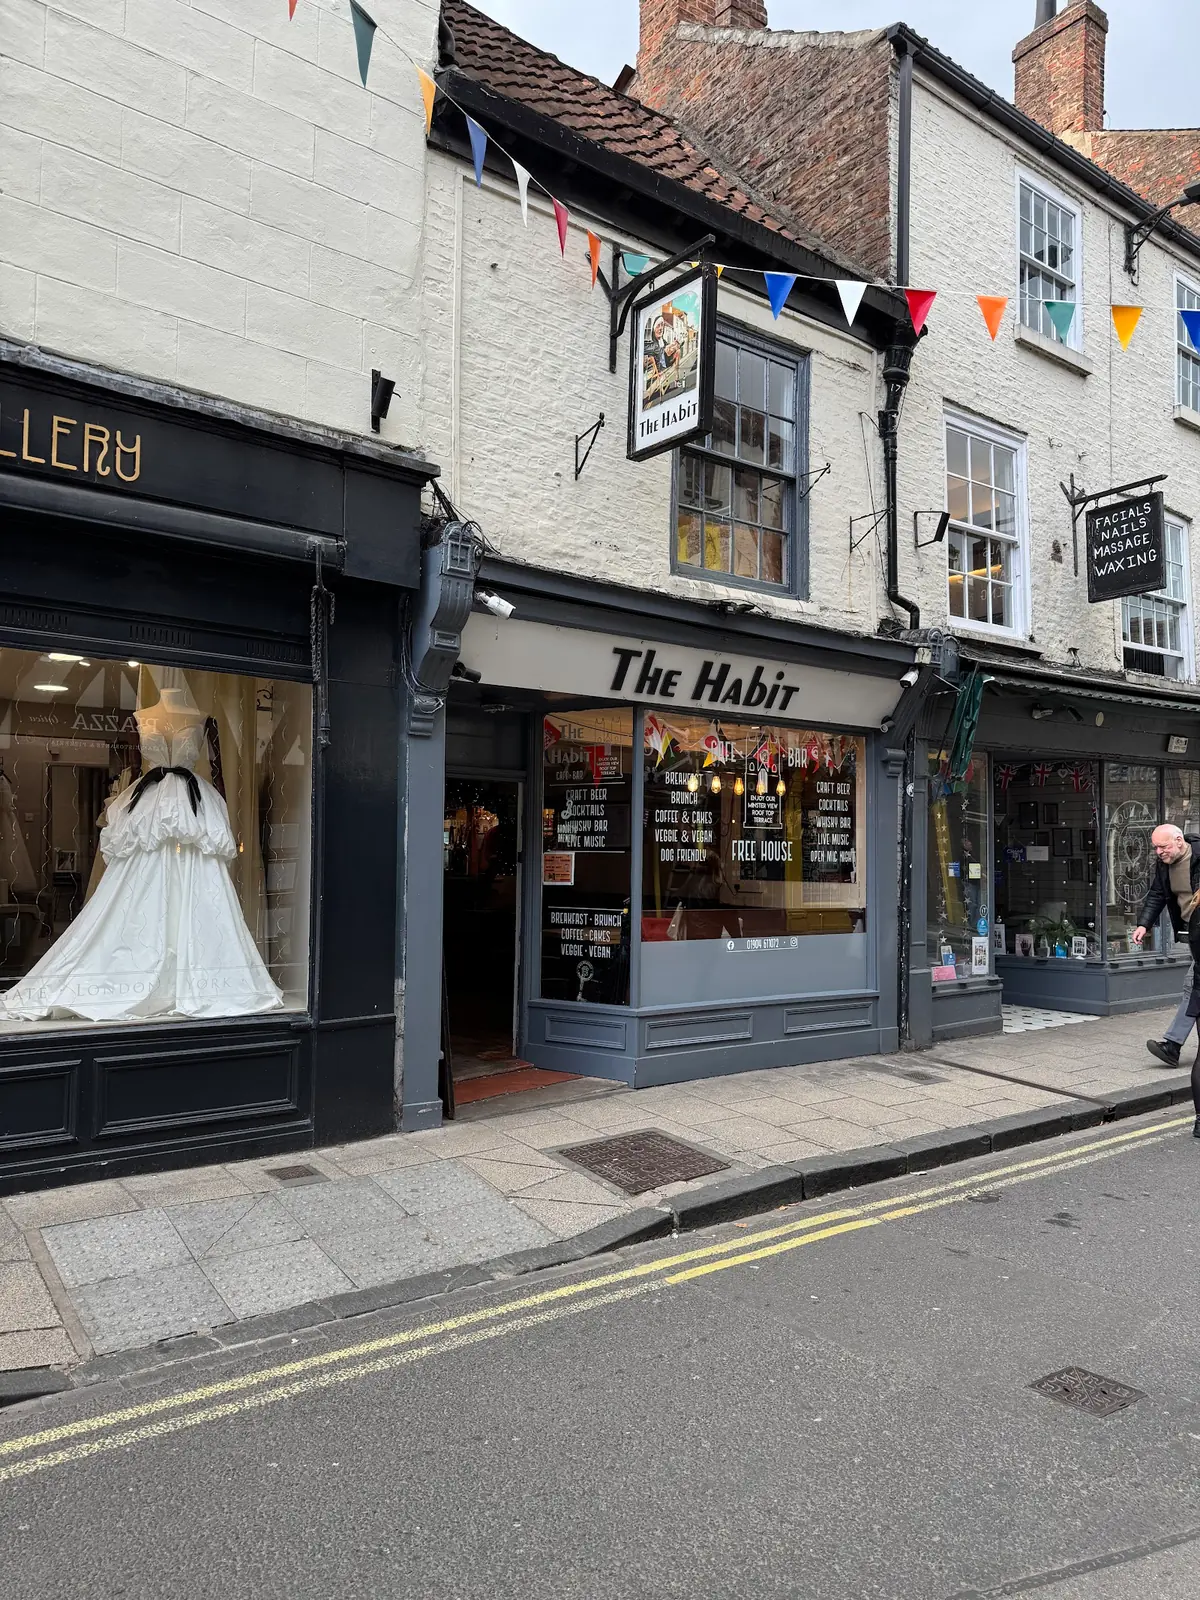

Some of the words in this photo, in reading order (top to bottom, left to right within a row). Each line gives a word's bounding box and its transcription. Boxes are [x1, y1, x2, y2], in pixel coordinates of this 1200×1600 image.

[1095, 502, 1152, 529] FACIALS
[1101, 517, 1147, 541] NAILS
[1094, 532, 1151, 559] MASSAGE
[1095, 548, 1158, 577] WAXING
[787, 747, 808, 768] BAR
[566, 789, 587, 800] CRAFT
[590, 788, 607, 800] BEER
[816, 782, 835, 794] CRAFT
[836, 782, 850, 795] BEER
[671, 791, 698, 804] BRUNCH
[818, 799, 848, 812] COCKTAILS
[655, 810, 678, 823] COFFEE
[681, 811, 690, 824] &
[692, 811, 713, 824] CAKES
[816, 816, 839, 829] WHISKY
[840, 817, 851, 829] BAR
[594, 820, 608, 832] BAR
[583, 836, 606, 847] MUSIC
[655, 829, 678, 842] VEGGIE
[681, 830, 690, 843] &
[692, 830, 713, 843] VEGAN
[817, 833, 830, 845] LIVE
[831, 834, 850, 846] MUSIC
[660, 849, 675, 861] DOG
[676, 849, 707, 862] FRIENDLY
[732, 840, 756, 861] FREE
[761, 841, 793, 862] HOUSE
[810, 850, 825, 863] OPEN
[826, 850, 838, 863] MIC
[550, 911, 588, 925] BREAKFAST
[594, 913, 622, 927] BRUNCH
[561, 927, 584, 941] COFFEE
[588, 929, 611, 943] CAKES
[560, 943, 584, 957] VEGGIE
[588, 945, 611, 959] VEGAN
[77, 978, 161, 997] LONDON
[186, 977, 232, 990] YORK
